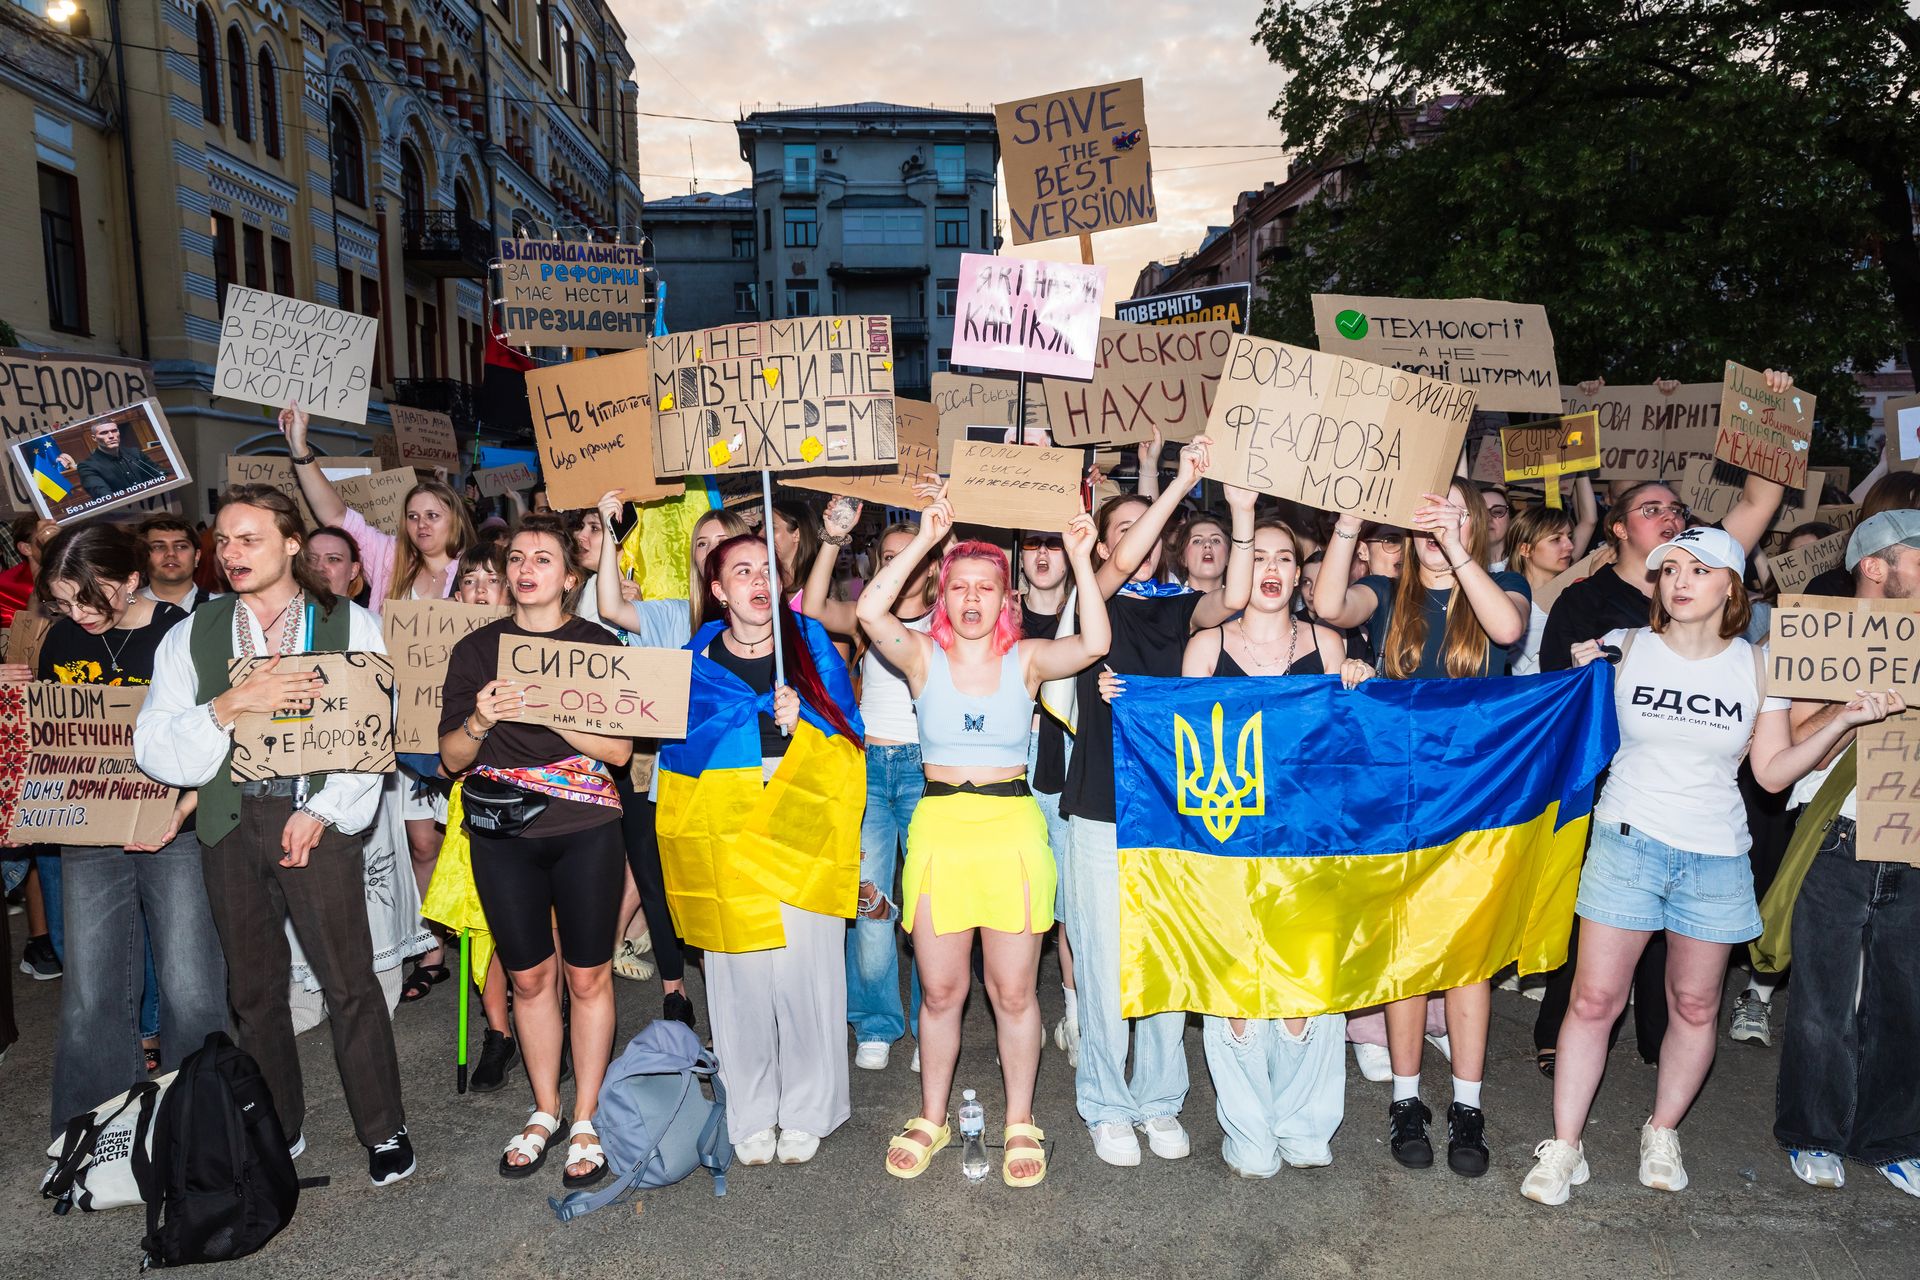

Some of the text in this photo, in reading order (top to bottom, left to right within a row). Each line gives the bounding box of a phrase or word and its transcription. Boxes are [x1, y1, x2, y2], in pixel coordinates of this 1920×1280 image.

[1012, 88, 1127, 145] SAVE
[1058, 139, 1100, 164] THE
[1033, 155, 1121, 200] BEST
[1010, 160, 1155, 241] VERSION!
[507, 263, 639, 286] ЗА РЕФОРМИ
[976, 264, 1025, 296] ЯКІ
[515, 286, 629, 305] МАЄ НЕСТИ
[230, 286, 376, 341] ТЕХНОЛОГІЇ
[1118, 294, 1202, 325] ПОВЕРНІТЬ
[223, 316, 351, 359] В БРУХТ?
[710, 324, 760, 360] НЕ
[1371, 317, 1524, 340] ТЕХНОЛОГІЇ
[1094, 330, 1230, 369] РСЬКОГО
[1418, 346, 1476, 360] А НЕ
[220, 342, 367, 391] ЛЮДЕЙ В
[1228, 338, 1319, 399] ВОВА,
[1335, 359, 1410, 402] ВСЬО
[1460, 367, 1552, 389] ШТУРМИ
[223, 368, 328, 411] ОКОПИ
[537, 384, 583, 439] Не
[1642, 403, 1723, 431] ВИРНІТ
[1224, 404, 1402, 473] ФЕДОРОВА
[1506, 422, 1571, 457] СИРУ
[965, 445, 1064, 463] КОЛИ ВИ
[1715, 428, 1806, 488] МЕХАНІЗМ
[238, 463, 275, 480] 404
[1247, 451, 1394, 518] В МО!!!
[964, 476, 1077, 496] НАЖЕРЕТЕСЬ?
[65, 502, 84, 515] Без
[85, 493, 112, 508] нього
[113, 489, 125, 499] не
[1777, 555, 1798, 572] НЕ
[512, 644, 631, 681] СИРОК
[28, 686, 67, 718] МІЙ
[1632, 686, 1742, 722] БДСМ
[31, 722, 134, 747] ДОНЕЧЧИНА
[553, 714, 624, 730] НАМ НЕ ОК
[1641, 711, 1665, 719] БОЖЕ
[1688, 718, 1707, 726] СИЛ
[1709, 722, 1730, 731] МЕНІ
[28, 754, 96, 775] ПОМИЛКИ
[23, 778, 169, 800] ДОМУ, ДУРНІ РІШЕННЯ
[16, 804, 88, 828] ЖИТТІВ.
[471, 815, 495, 830] PUMA
[96, 1137, 131, 1148] АВЖДИ
[98, 1130, 132, 1141] ІЛИВІ
[95, 1144, 129, 1156] АЮТЬ
